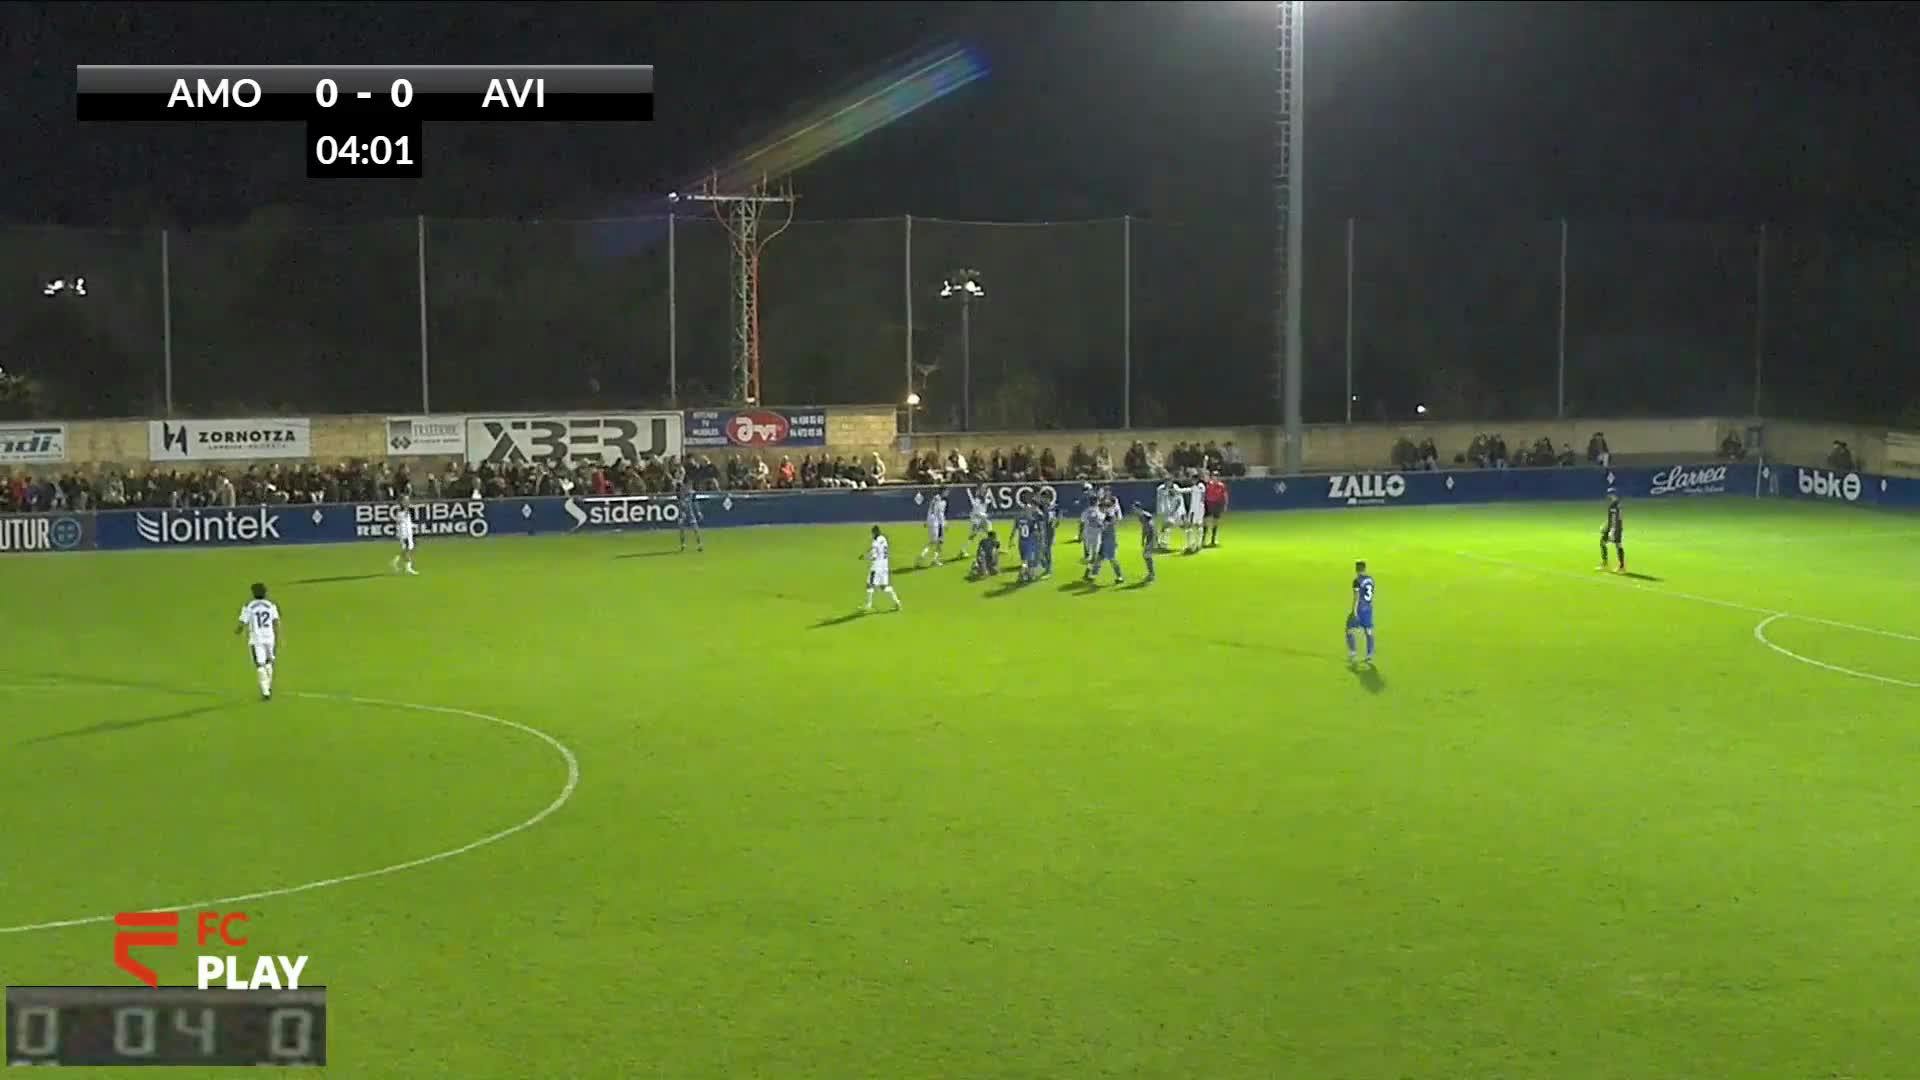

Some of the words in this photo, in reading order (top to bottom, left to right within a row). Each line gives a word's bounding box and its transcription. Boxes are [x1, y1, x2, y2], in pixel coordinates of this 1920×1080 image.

[198, 430, 295, 443] ZORNOTZA
[1328, 475, 1406, 498] ZALLO
[1650, 465, 1727, 494] Larrea
[1800, 469, 1841, 497] bbk
[0, 518, 51, 549] UTUR
[162, 506, 280, 542] lointek
[356, 522, 468, 537] RECLING
[1364, 584, 1373, 602] 3
[255, 610, 270, 628] 12
